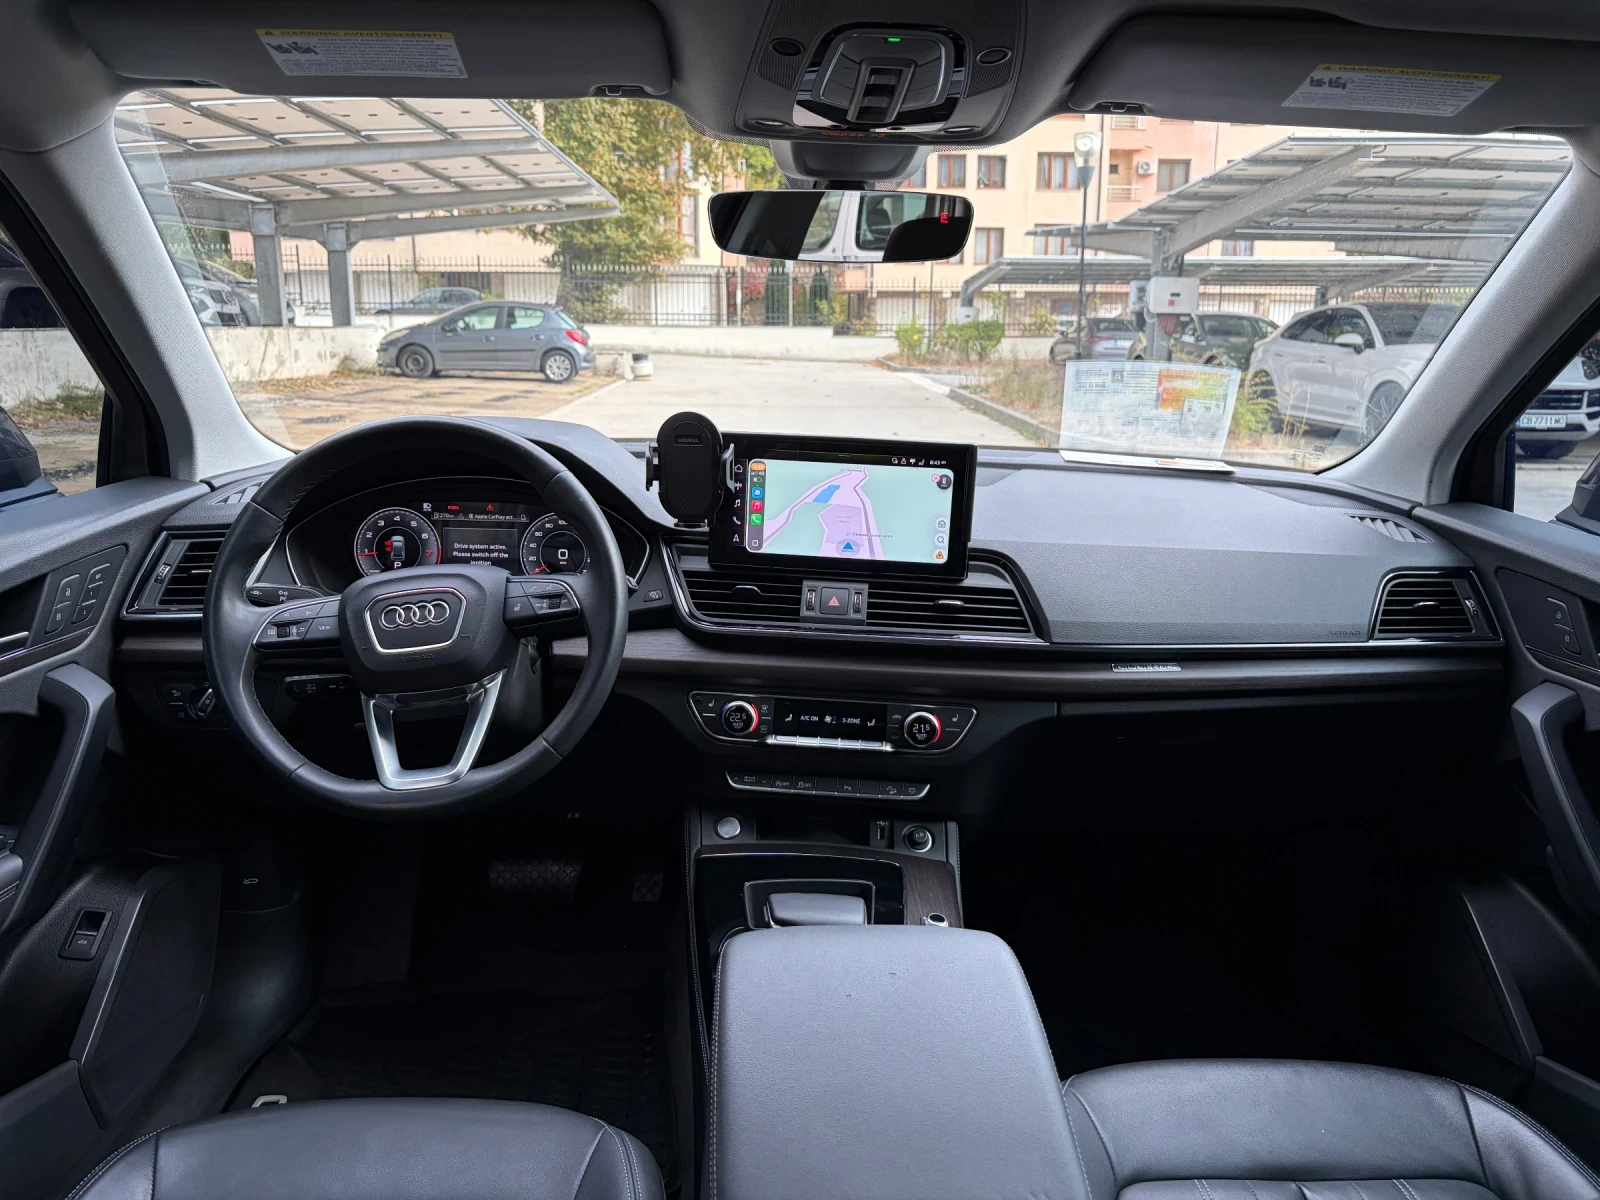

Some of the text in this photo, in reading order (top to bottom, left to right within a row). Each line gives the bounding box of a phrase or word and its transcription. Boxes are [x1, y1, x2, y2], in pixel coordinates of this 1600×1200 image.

[1338, 65, 1491, 80] WARNING! AVERTISSEMENT!
[940, 212, 949, 224] E
[557, 548, 569, 560] 0
[730, 712, 747, 722] 22.5
[912, 724, 930, 733] 21.5
